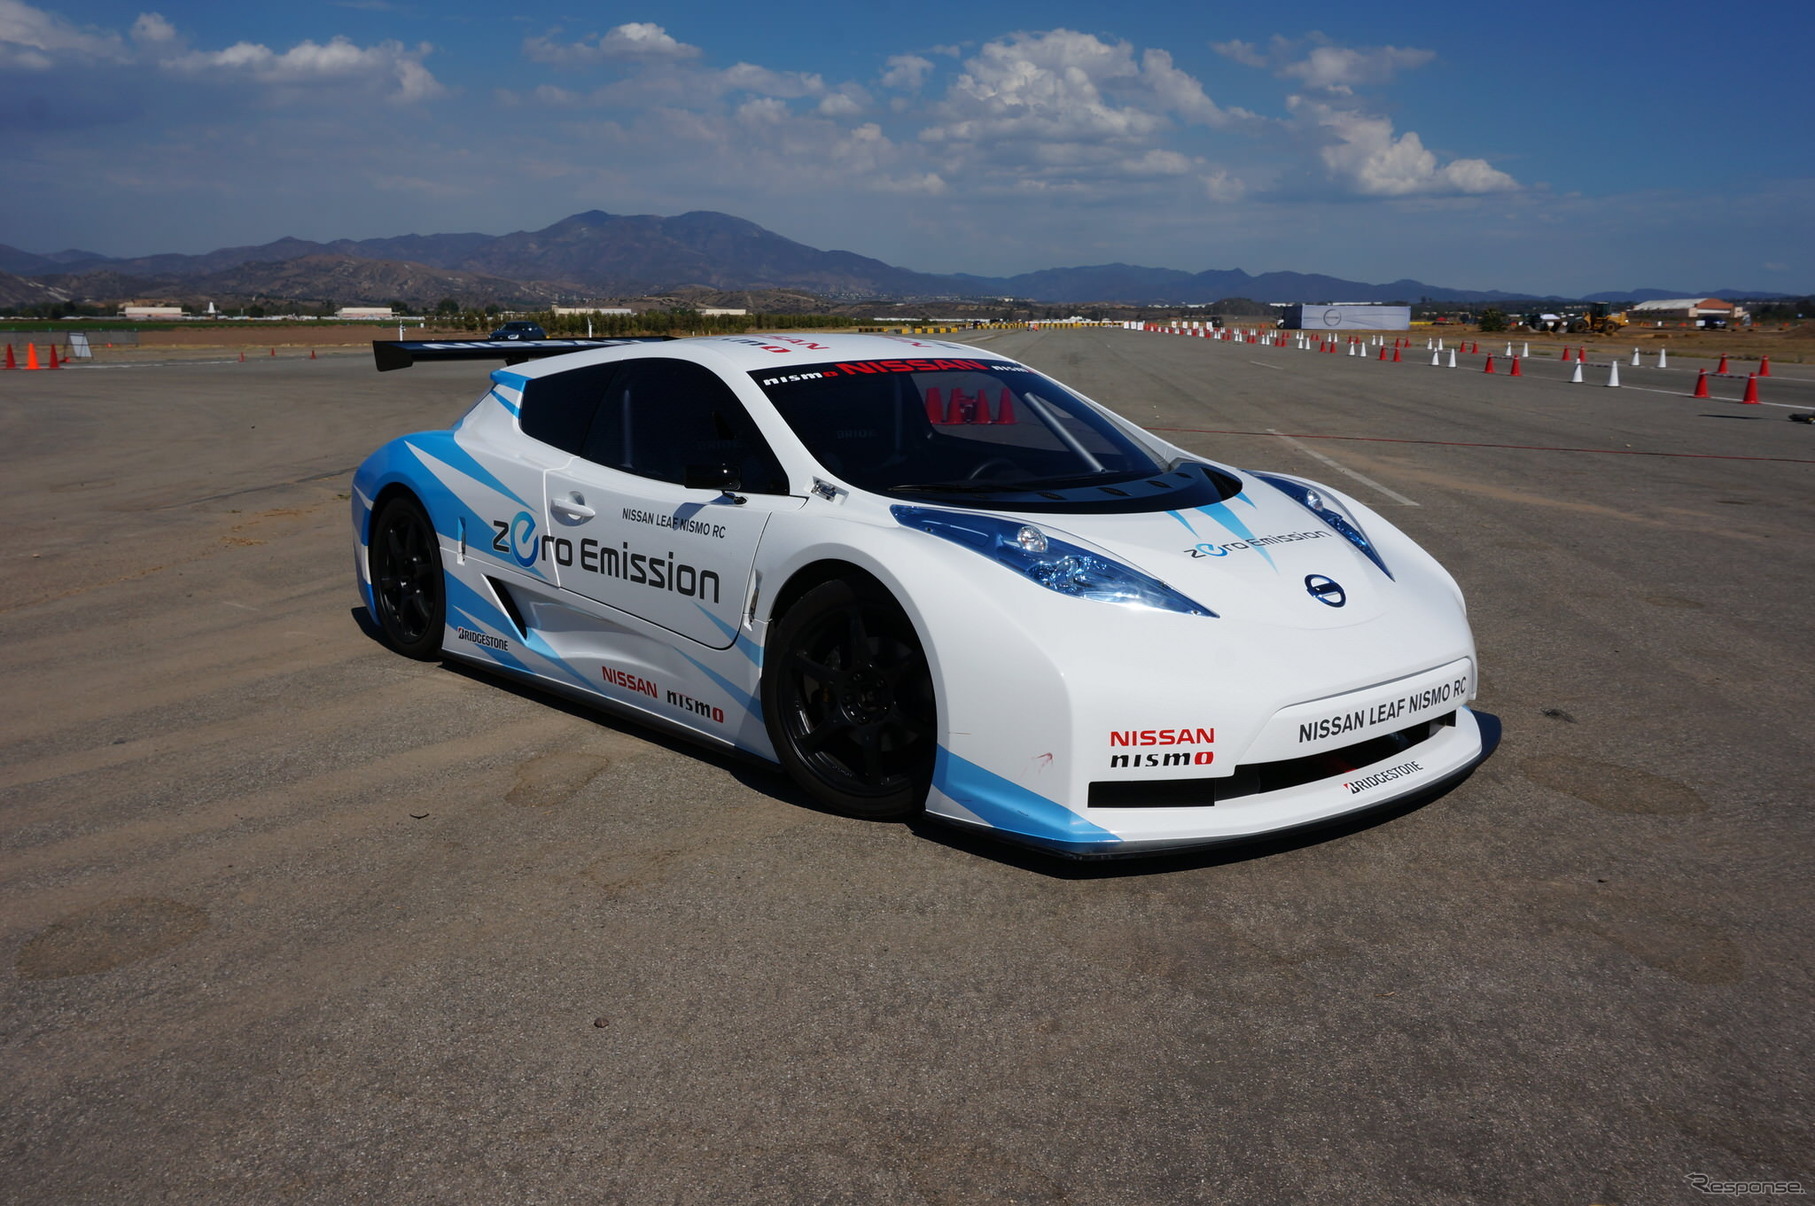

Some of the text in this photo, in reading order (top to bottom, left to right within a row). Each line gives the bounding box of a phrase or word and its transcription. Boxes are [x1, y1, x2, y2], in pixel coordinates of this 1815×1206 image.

[763, 370, 839, 386] nismo
[834, 359, 989, 376] NISSAN
[621, 507, 727, 540] NISSAN LEAF NISMO RC
[492, 511, 720, 604] zero Emission
[1183, 529, 1332, 559] zero Emission
[457, 627, 509, 652] BRIDGESTONE
[602, 665, 724, 724] NISSAN nismo
[1298, 676, 1468, 744] NISSAN LEAF NISMO RC
[1109, 727, 1215, 748] NISSAN
[1110, 750, 1214, 769] nismo
[1343, 760, 1424, 796] BRIDGESTONE
